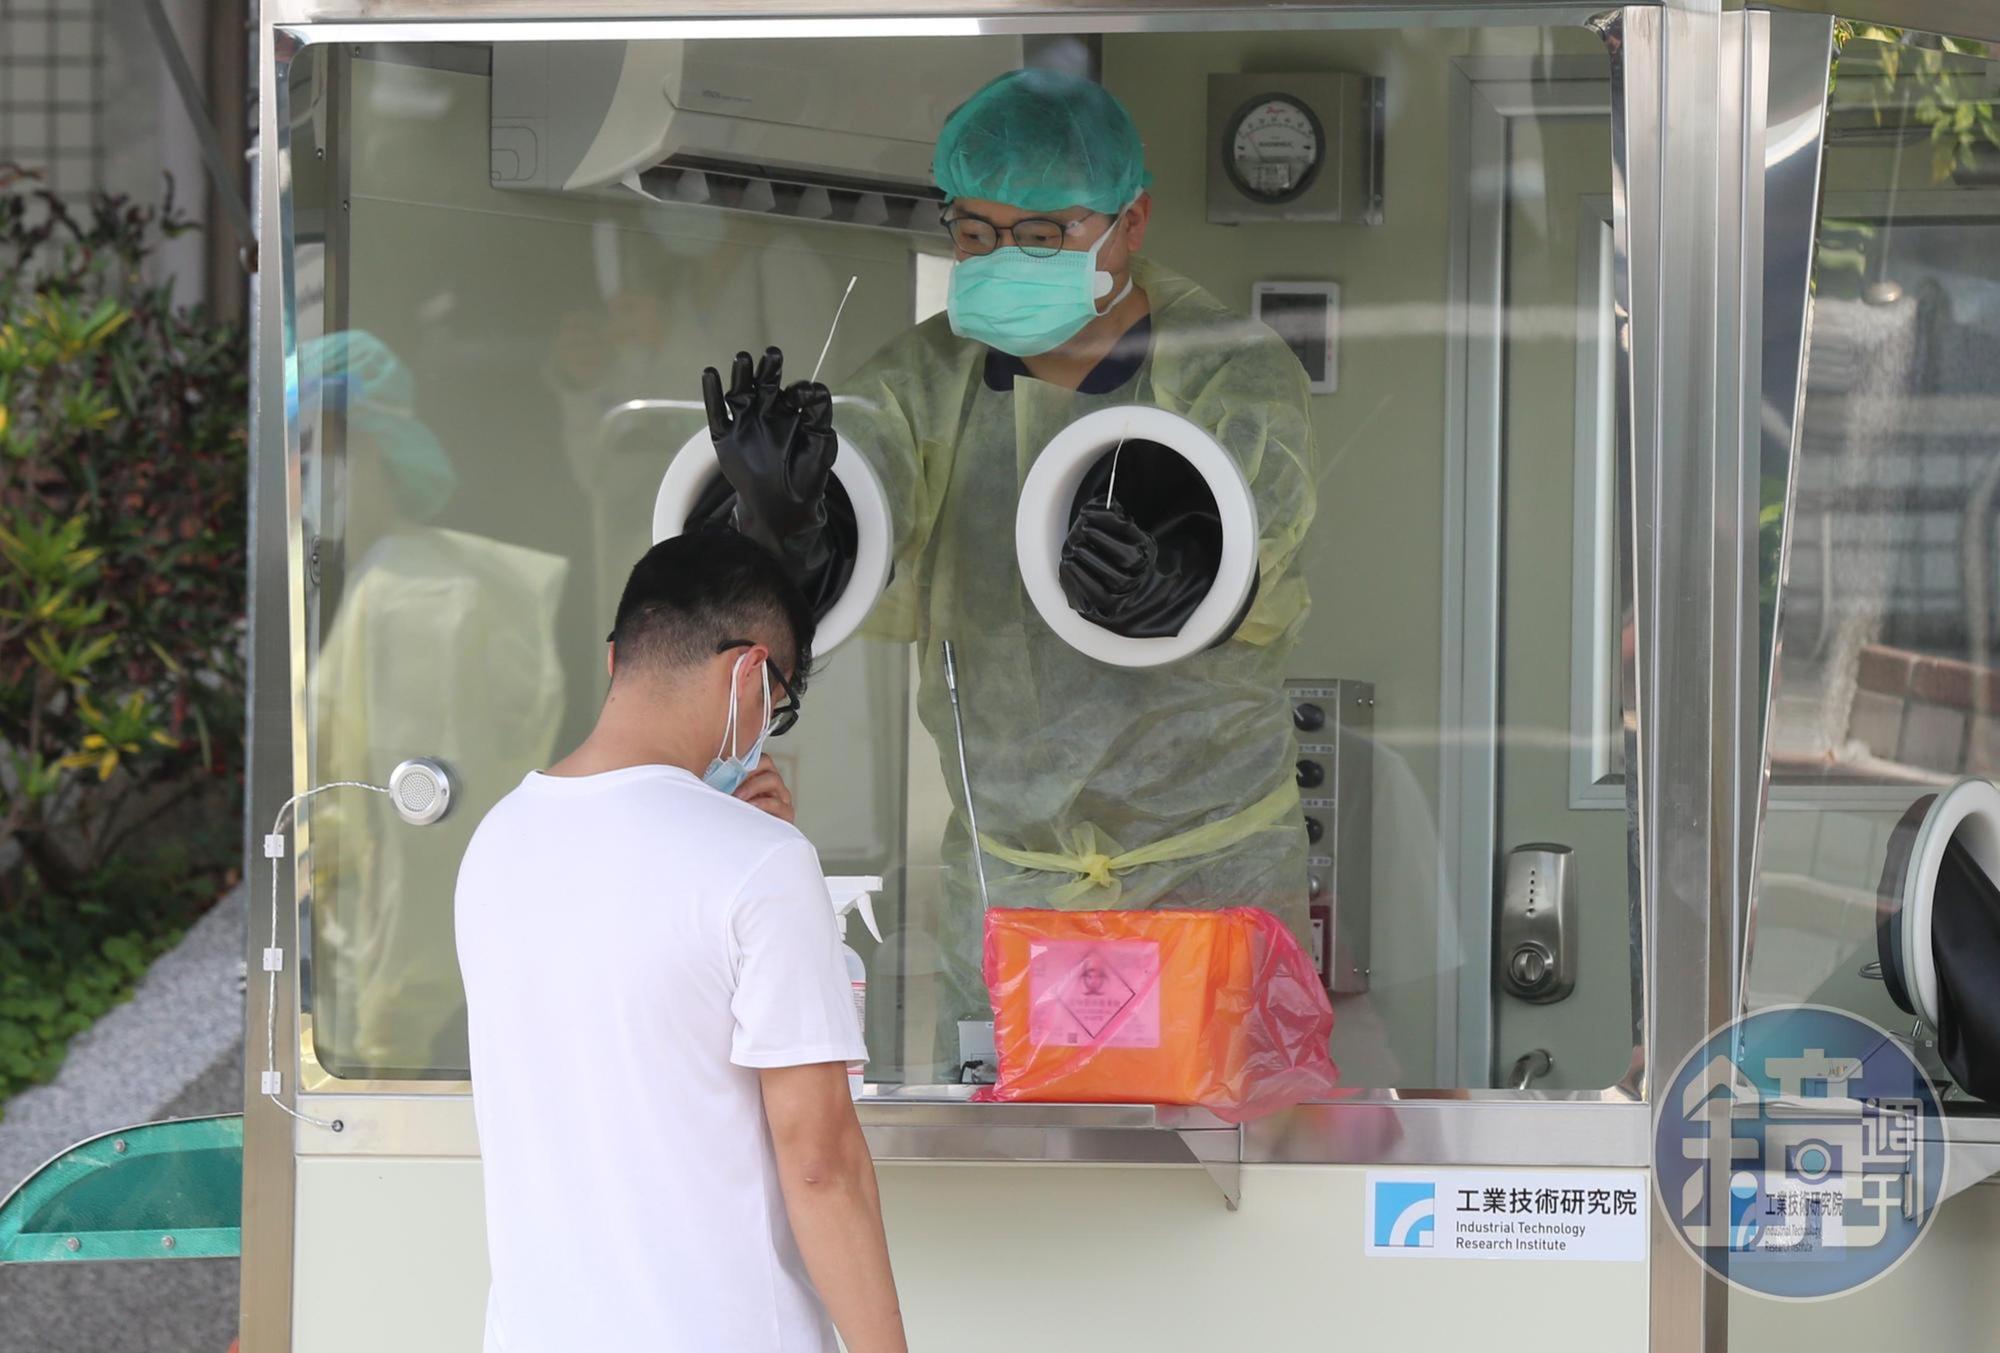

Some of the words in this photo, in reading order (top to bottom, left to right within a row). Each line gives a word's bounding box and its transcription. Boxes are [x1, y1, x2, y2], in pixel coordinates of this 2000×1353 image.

[1456, 1187, 1637, 1215] 工業技術研究院
[1765, 1190, 1843, 1217] 工業技術研究院
[1456, 1221, 1515, 1234] Industrial
[1518, 1222, 1586, 1237] Technology
[1456, 1237, 1512, 1250] Research
[1516, 1239, 1566, 1251] Institute
